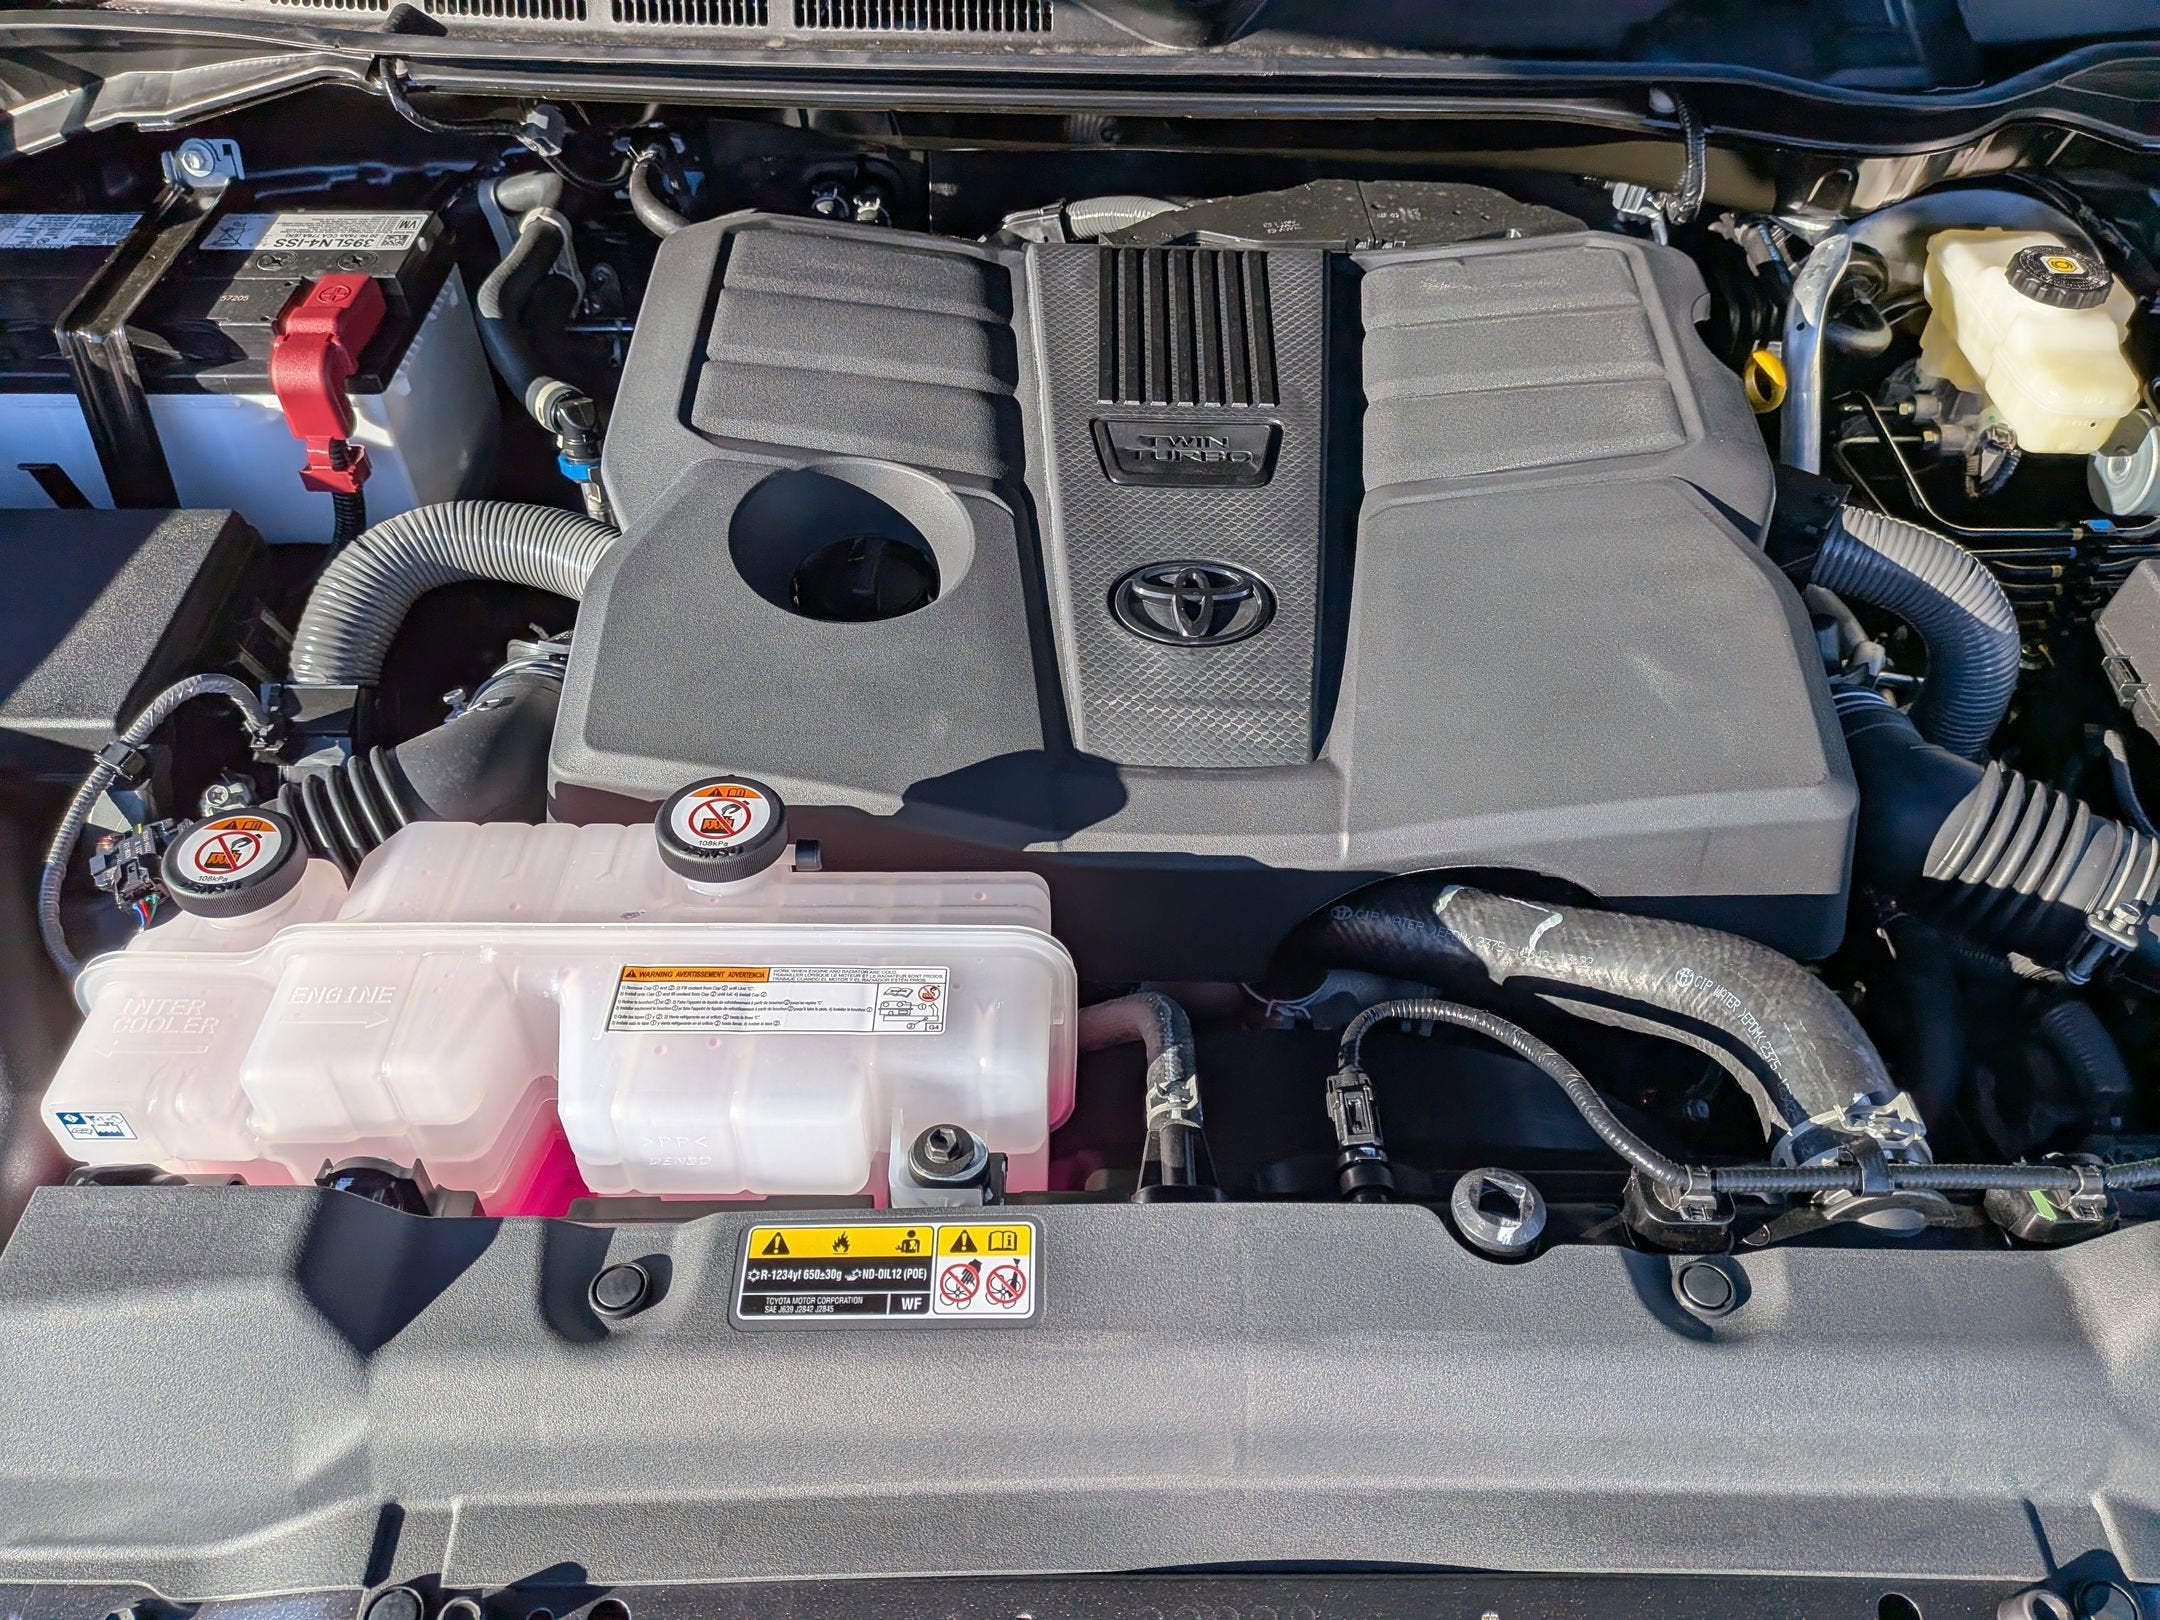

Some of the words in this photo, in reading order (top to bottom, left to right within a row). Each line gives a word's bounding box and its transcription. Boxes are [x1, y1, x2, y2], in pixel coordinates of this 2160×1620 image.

[399, 220, 417, 229] VM
[273, 238, 375, 248] 395LN4-ISS
[1139, 435, 1230, 449] TWIN
[1128, 449, 1253, 463] TURBO
[1385, 914, 1424, 932] WATER
[727, 971, 765, 979] ADVERTENCIA
[290, 985, 397, 1005] ENGINE
[121, 997, 207, 1016] INTER
[111, 1015, 220, 1035] COOLER
[1694, 975, 1714, 991] CIP
[1713, 984, 1742, 1013] WATER
[1760, 1041, 1782, 1072] 2375
[760, 1270, 802, 1282] R-1234yf
[803, 1269, 842, 1282] 650±30g
[862, 1268, 902, 1280] ND-OIL12
[903, 1268, 927, 1282] (POE)
[766, 1297, 791, 1305] TOYOTA
[792, 1297, 815, 1305] MOTOR
[816, 1296, 863, 1305] CORPORATION
[902, 1298, 922, 1311] WF
[765, 1305, 778, 1314] SAE
[778, 1305, 794, 1314] J639
[795, 1305, 815, 1314] J2842
[815, 1305, 834, 1313] J2845
